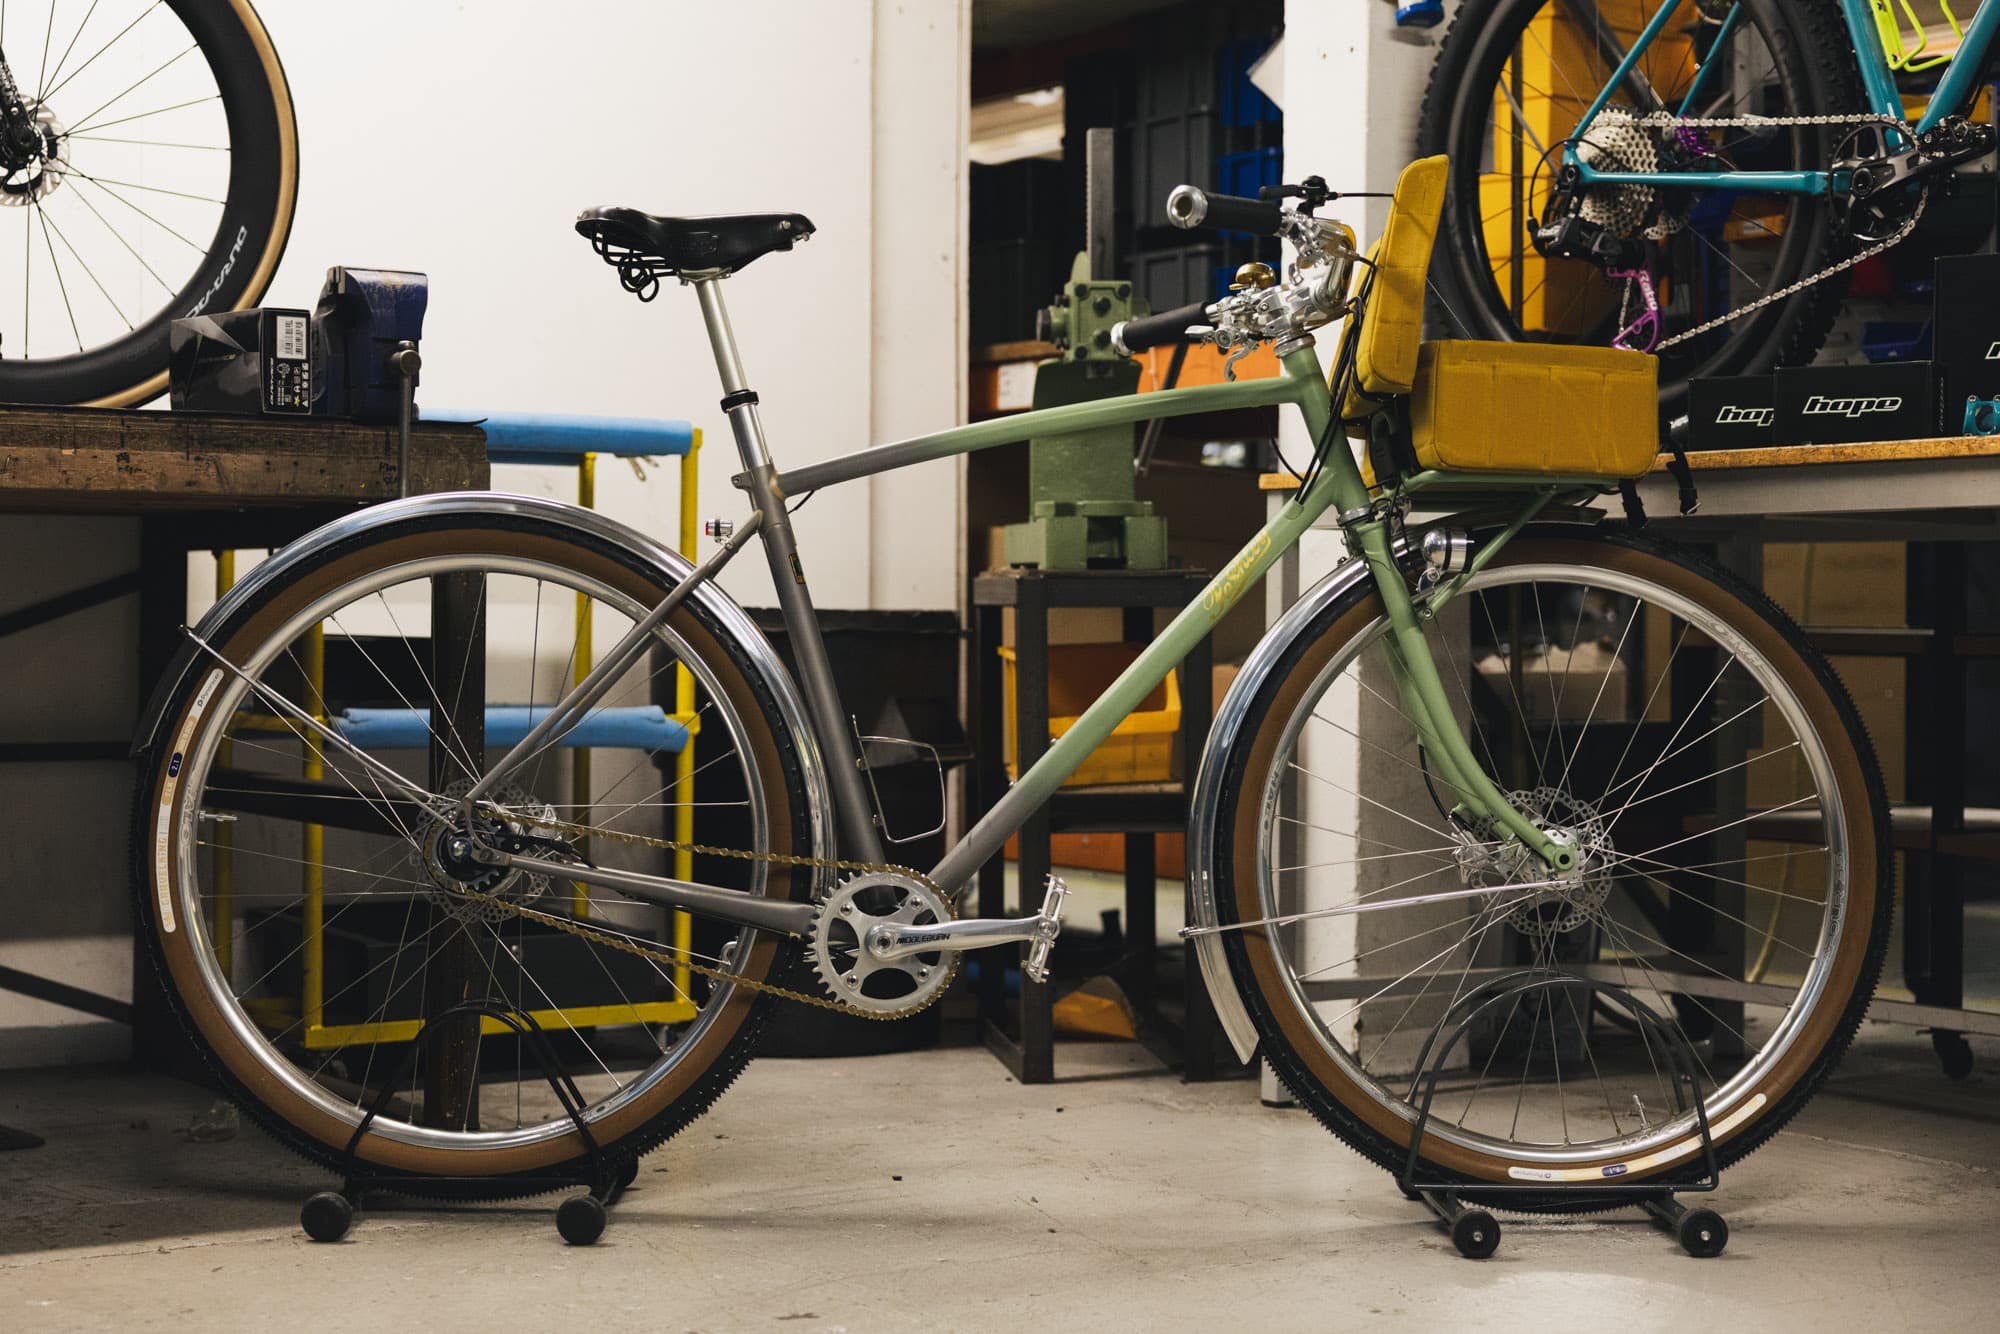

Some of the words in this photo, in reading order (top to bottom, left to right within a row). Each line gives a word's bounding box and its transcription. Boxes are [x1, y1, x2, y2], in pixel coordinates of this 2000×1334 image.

[1803, 396, 1902, 417] hope
[171, 759, 181, 772] 2.1
[896, 933, 951, 944] MIDDLEBURN
